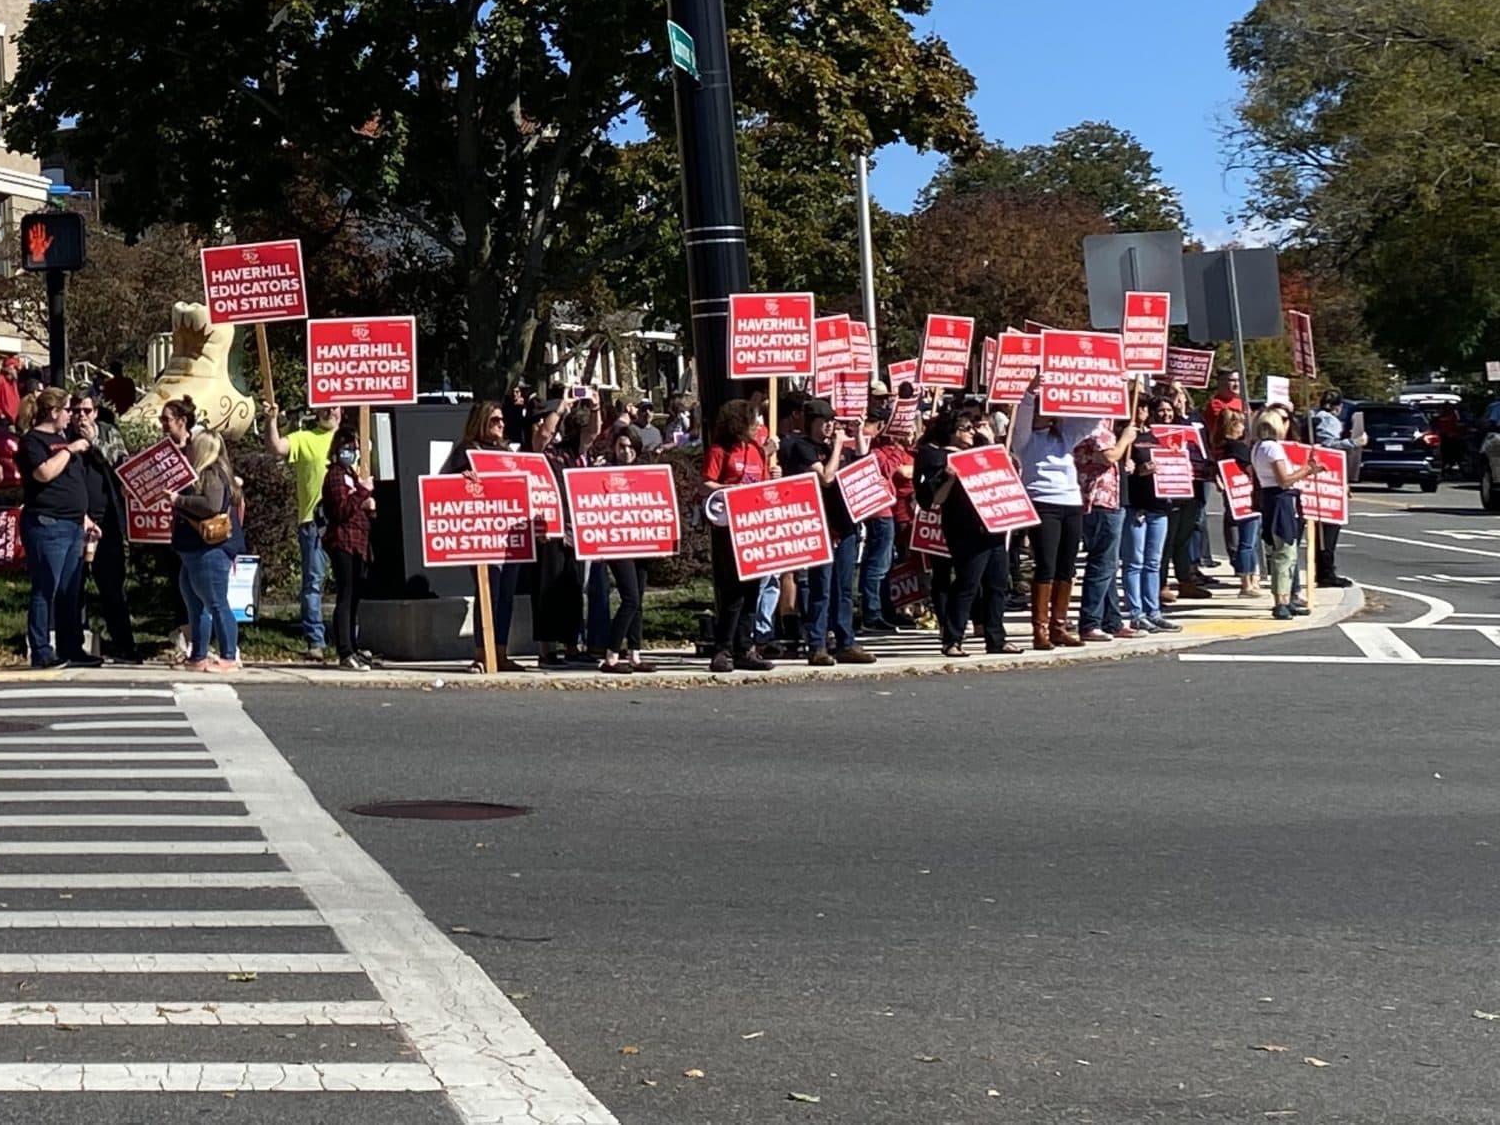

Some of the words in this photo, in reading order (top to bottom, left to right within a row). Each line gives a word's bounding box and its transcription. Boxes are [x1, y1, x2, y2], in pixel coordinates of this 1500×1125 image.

[212, 264, 295, 282] HAVERHILL
[209, 278, 300, 298] EDUCATORS
[214, 299, 238, 313] ON
[241, 293, 298, 310] STRIKE!
[737, 318, 807, 331] HAVERHILL
[734, 334, 810, 347] EDUCATORS
[316, 343, 407, 359] HAVERHILL
[736, 350, 758, 363] ON
[758, 349, 806, 362] STRIKE!
[313, 359, 411, 376] EDUCATORS
[1049, 355, 1118, 372] HAVERHILL
[317, 378, 342, 393] ON
[344, 376, 407, 391] STRIKE!
[1045, 371, 1125, 389] EDUCATORS
[1048, 388, 1069, 401] ON
[1072, 389, 1123, 404] STRIKE!
[155, 446, 173, 461] OUR
[130, 453, 179, 488] STUDENTS
[429, 498, 523, 516] HAVERHILL
[577, 490, 668, 508] HAVERHILL
[134, 516, 156, 528] ON
[576, 508, 674, 525] EDUCATORS
[735, 501, 816, 528] HAVERHILL
[426, 517, 528, 534] EDUCATORS
[735, 518, 821, 546] EDUCATORS
[431, 535, 459, 551] ON
[460, 534, 525, 550] STRIKE!
[582, 528, 611, 543] ON
[612, 526, 671, 541] STRIKE!
[742, 547, 764, 563] ON
[766, 536, 822, 559] STRIKE!
[890, 575, 918, 602] OW
